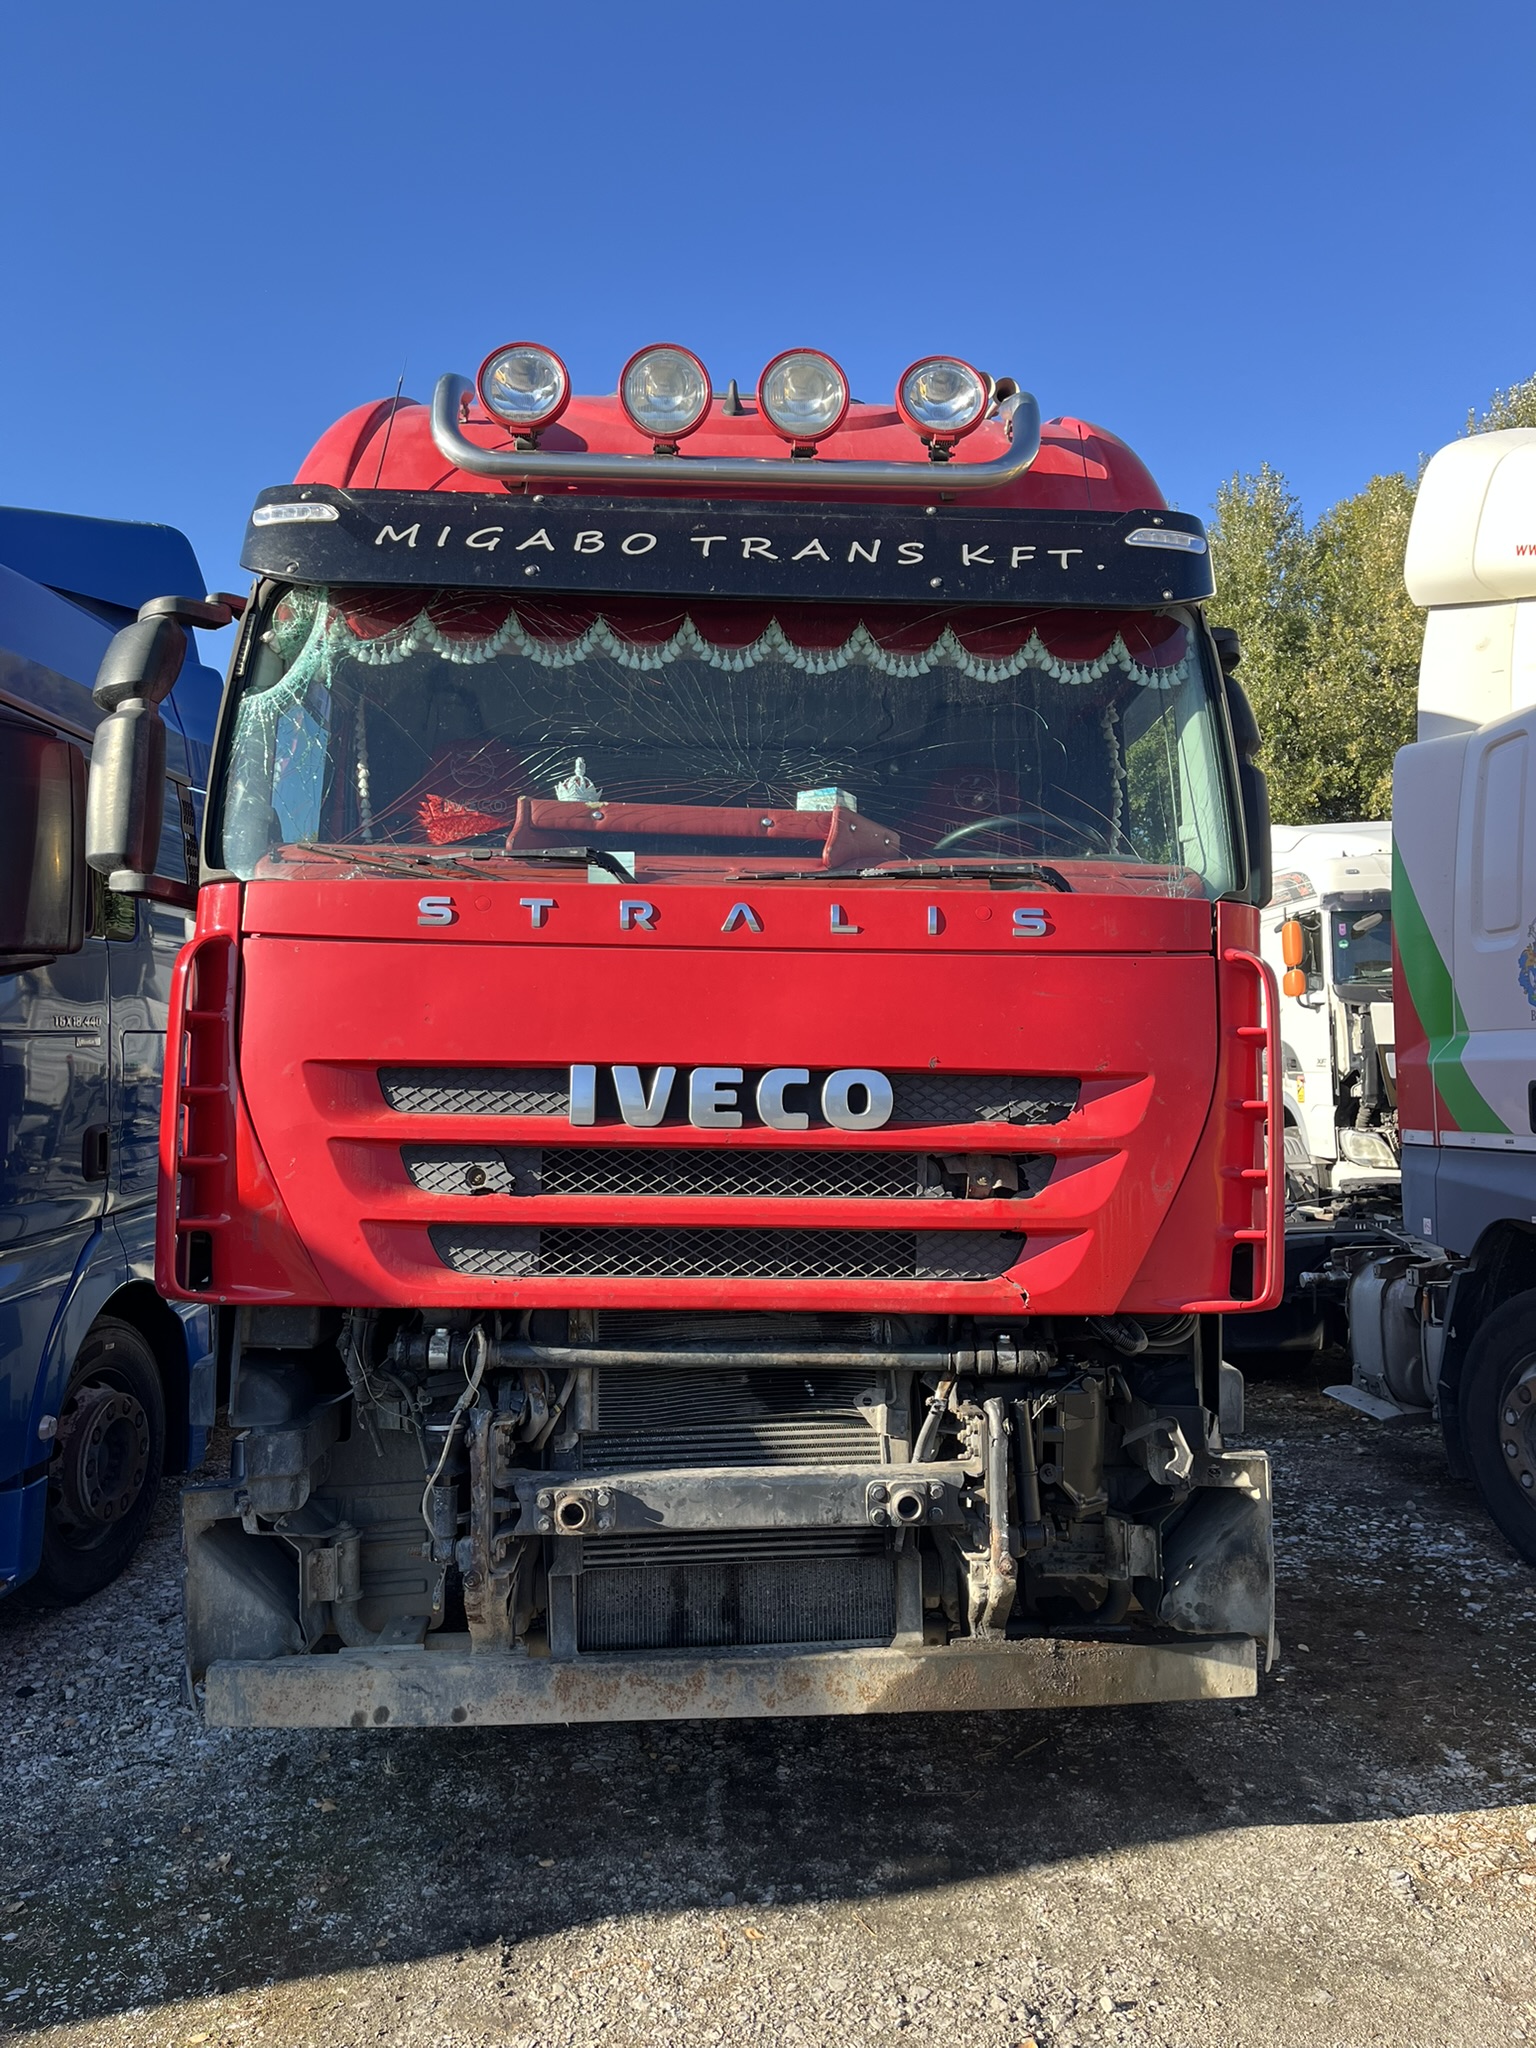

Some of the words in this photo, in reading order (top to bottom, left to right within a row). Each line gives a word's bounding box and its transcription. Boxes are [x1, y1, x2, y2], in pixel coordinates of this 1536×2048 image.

[375, 523, 656, 557] MIGABO
[691, 535, 925, 567] TRANS
[962, 542, 1105, 570] KFT.
[416, 895, 1048, 937] STRALIS
[569, 1064, 894, 1131] IVECO
